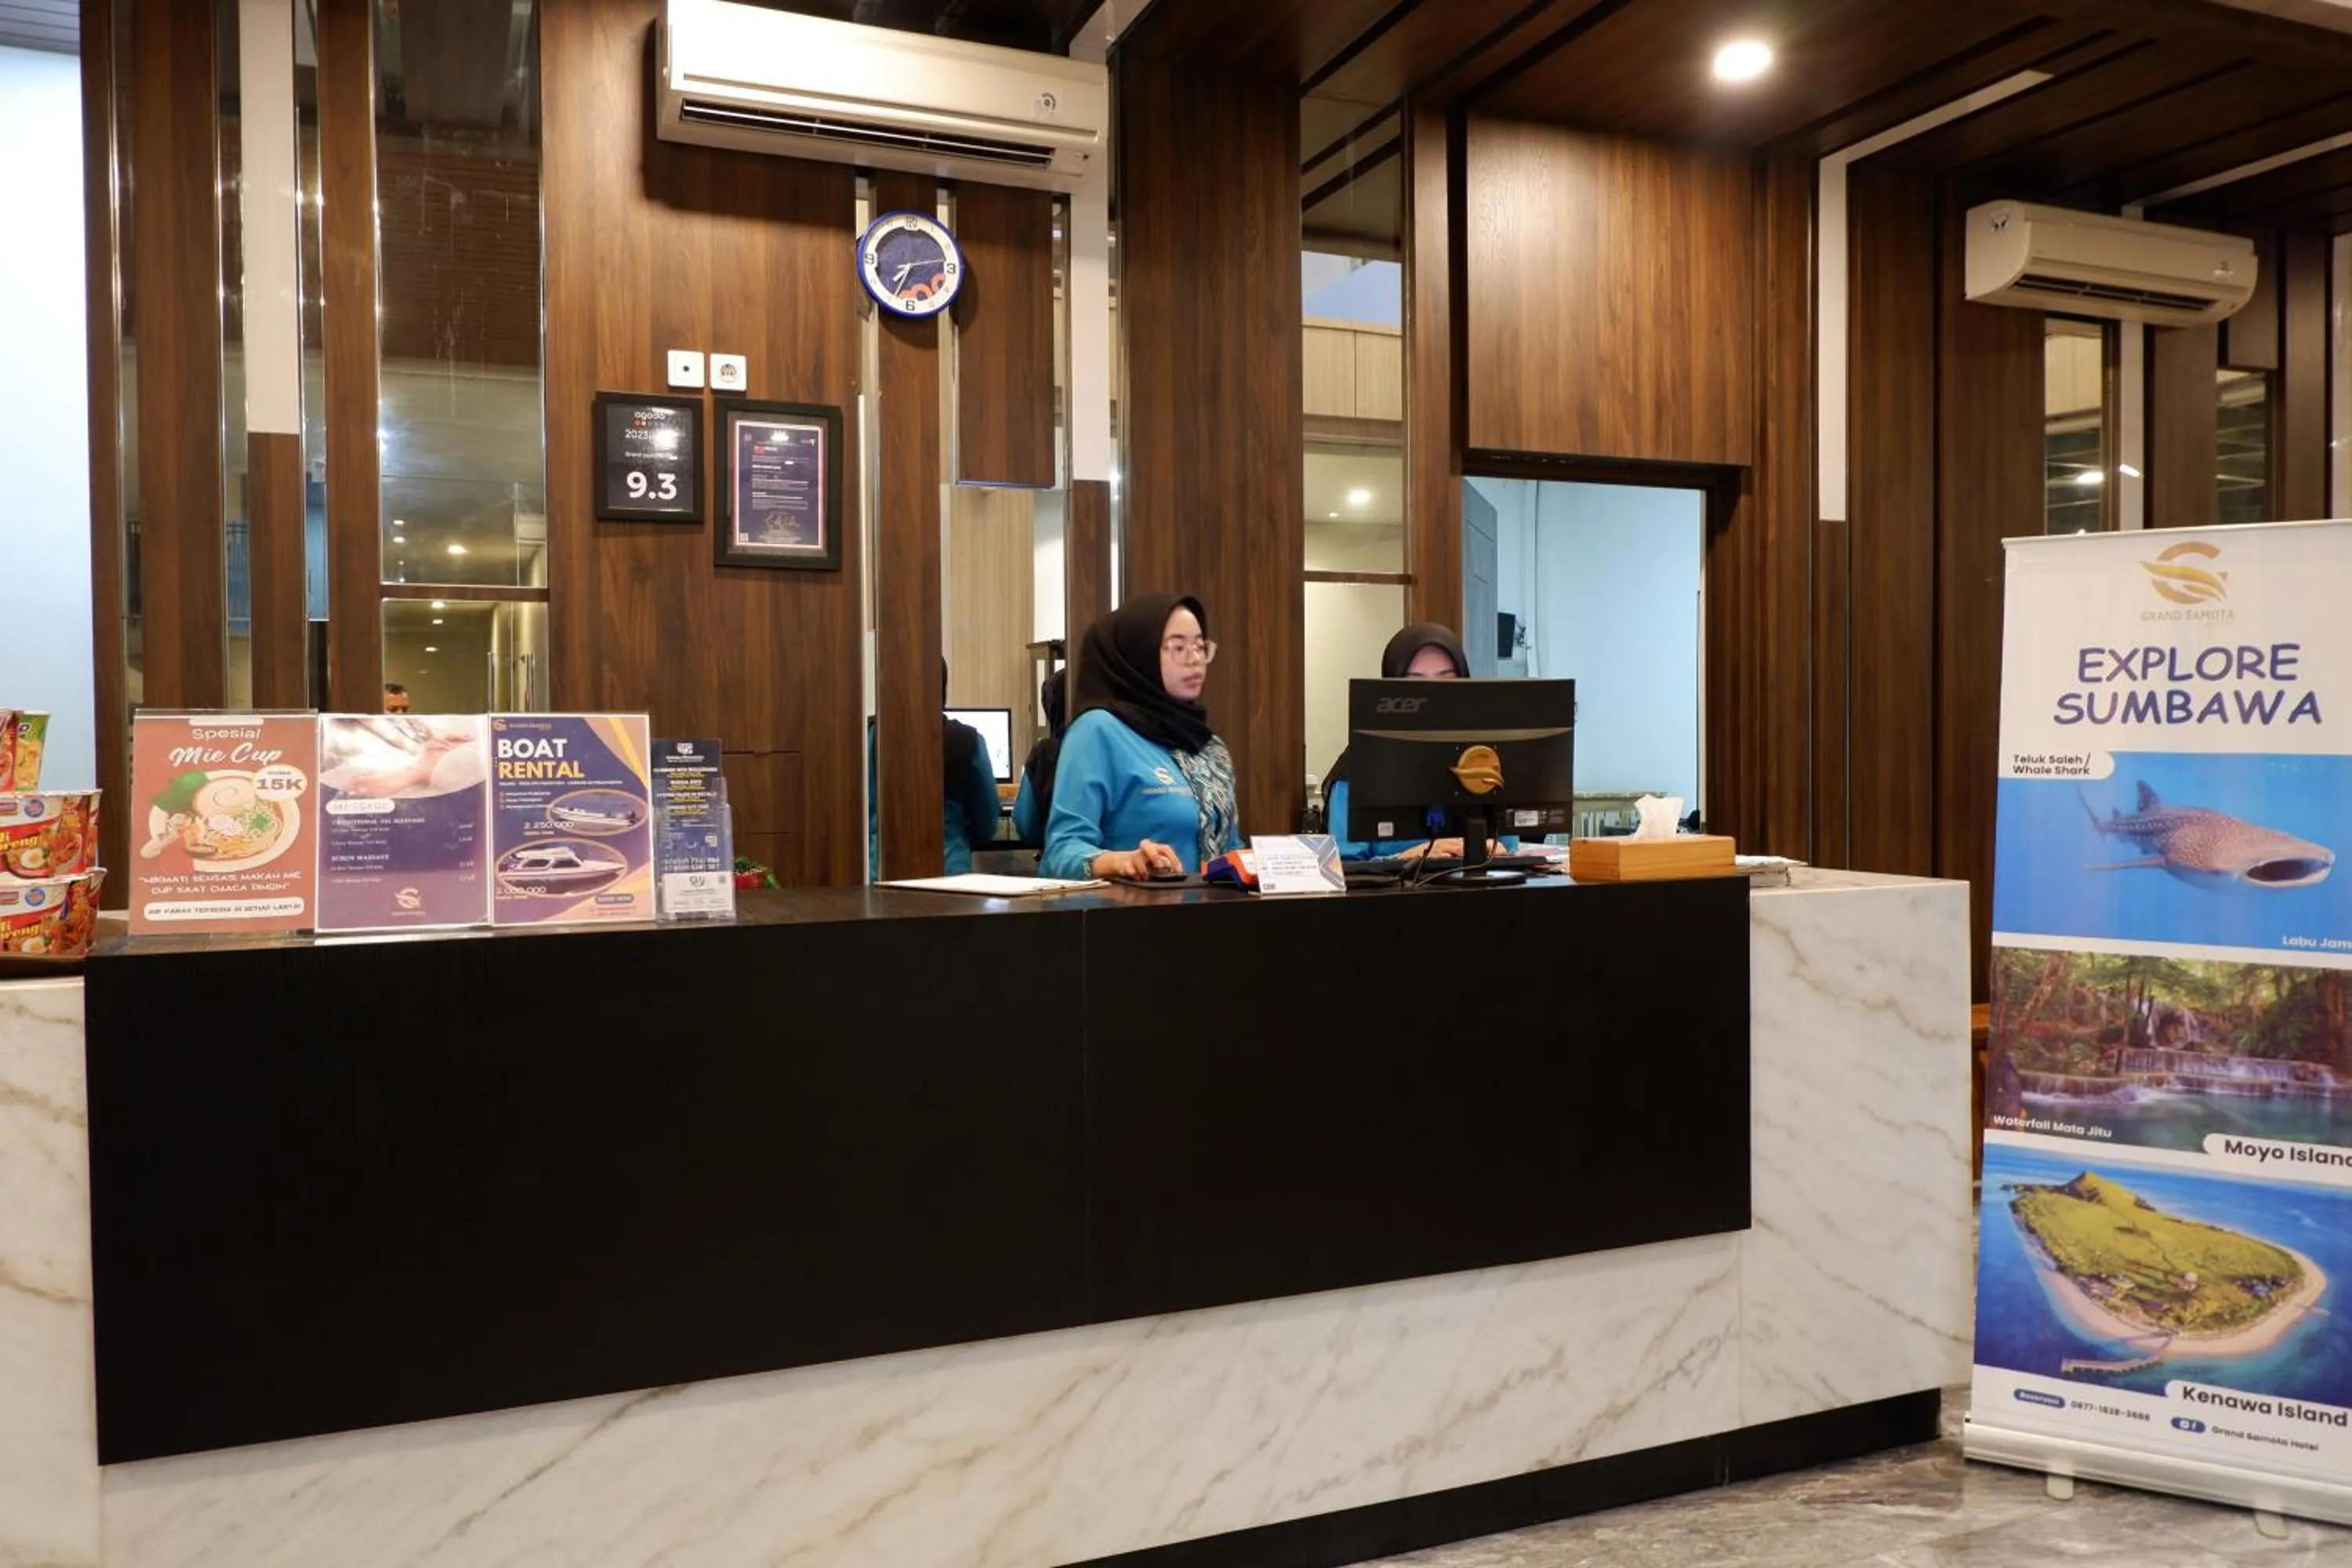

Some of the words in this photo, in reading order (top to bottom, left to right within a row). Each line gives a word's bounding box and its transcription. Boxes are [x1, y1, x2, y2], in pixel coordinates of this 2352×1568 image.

[946, 263, 956, 274] 3
[906, 299, 916, 311] 6
[627, 471, 677, 500] 9.3
[2140, 609, 2183, 622] GRAND
[2078, 644, 2301, 683] EXPLORE
[1376, 697, 1428, 713] acer
[2053, 689, 2322, 725] SUMBAWA
[192, 728, 261, 740] Spesial
[169, 746, 227, 768] Mie
[230, 742, 283, 765] Cup
[498, 739, 568, 759] BOAT
[2013, 754, 2045, 764] Teluk
[2049, 755, 2083, 764] Saleh
[499, 760, 585, 779] RENTAL
[2013, 765, 2052, 775] Whale
[2055, 766, 2091, 775] Shark
[256, 779, 303, 790] 15K
[2282, 935, 2317, 948] Labu
[1994, 1116, 2050, 1130] Waterfall
[2053, 1122, 2085, 1134] Mata
[2086, 1126, 2113, 1138] Jitu
[2224, 1139, 2285, 1163] Moyo
[2183, 1385, 2273, 1415] Kenawa
[2278, 1402, 2349, 1428] Island
[2212, 1425, 2245, 1439] Grand
